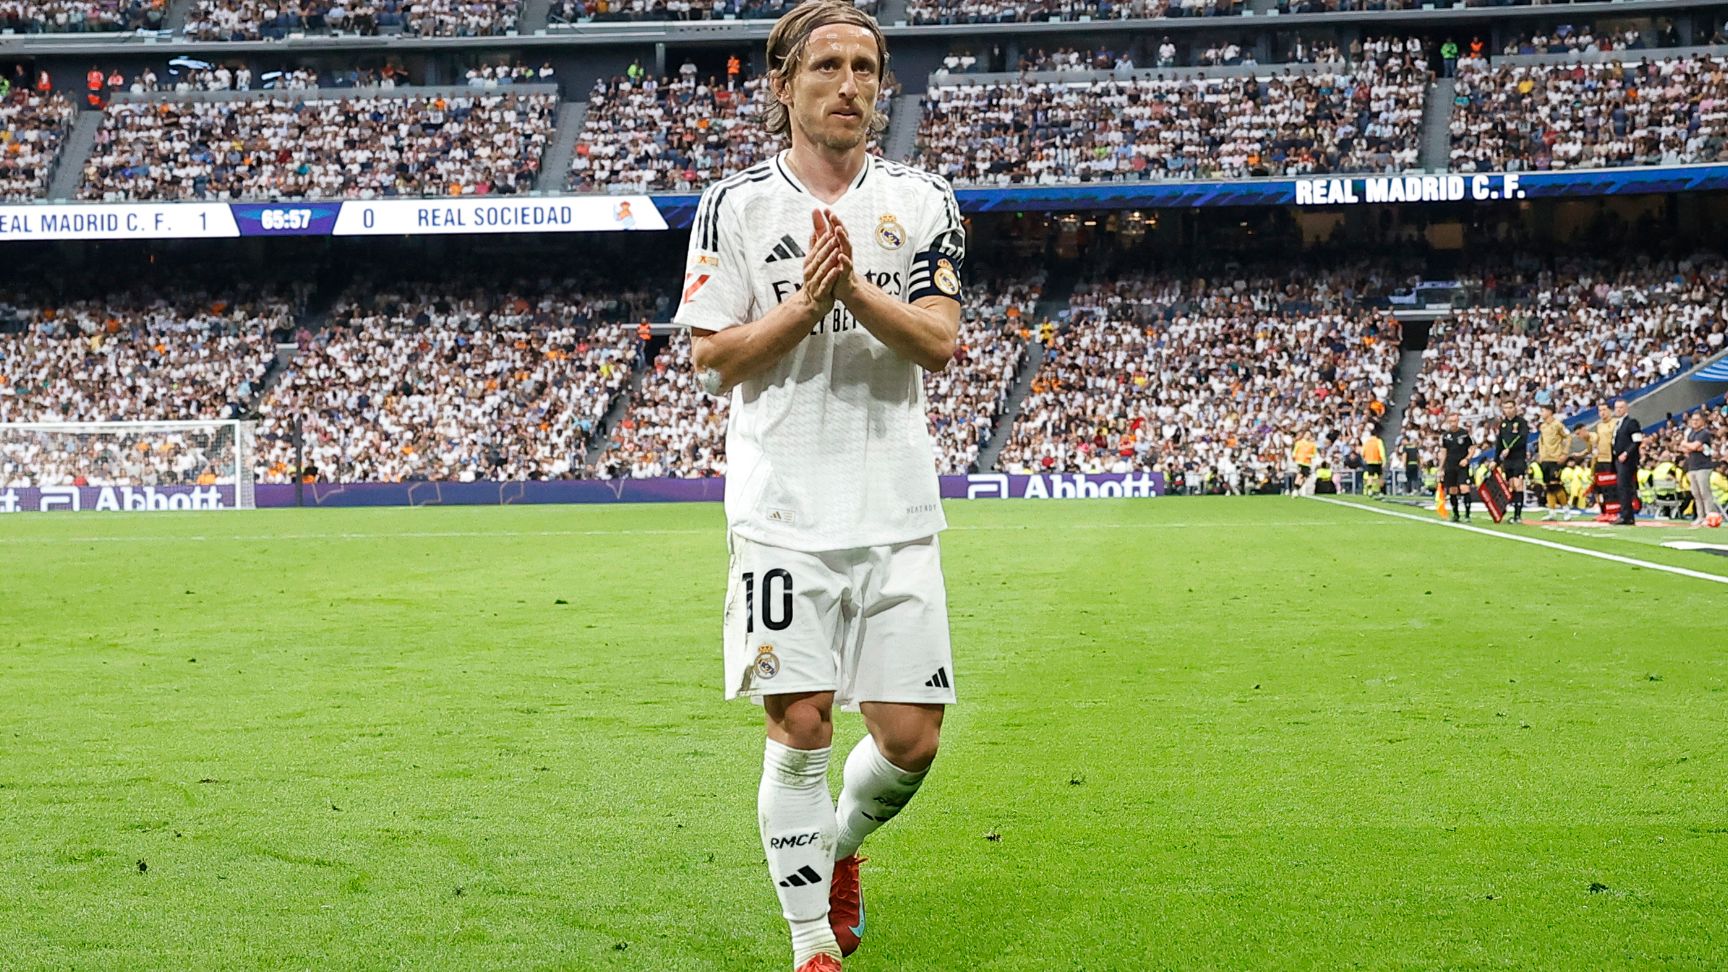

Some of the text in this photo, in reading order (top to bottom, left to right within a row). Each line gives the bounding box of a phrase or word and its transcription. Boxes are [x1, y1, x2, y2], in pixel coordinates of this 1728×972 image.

[1296, 174, 1526, 204] REAL MADRID C. F.
[0, 212, 172, 232] EAL MADRID C. F.
[198, 212, 207, 231] 1
[261, 208, 311, 230] 65:57
[363, 208, 374, 228] 0
[418, 205, 572, 227] REAL SOCIEDAD
[1024, 473, 1156, 499] Abbott
[95, 485, 223, 511] Abbott
[742, 568, 793, 633] 10
[770, 832, 819, 849] RMCF
